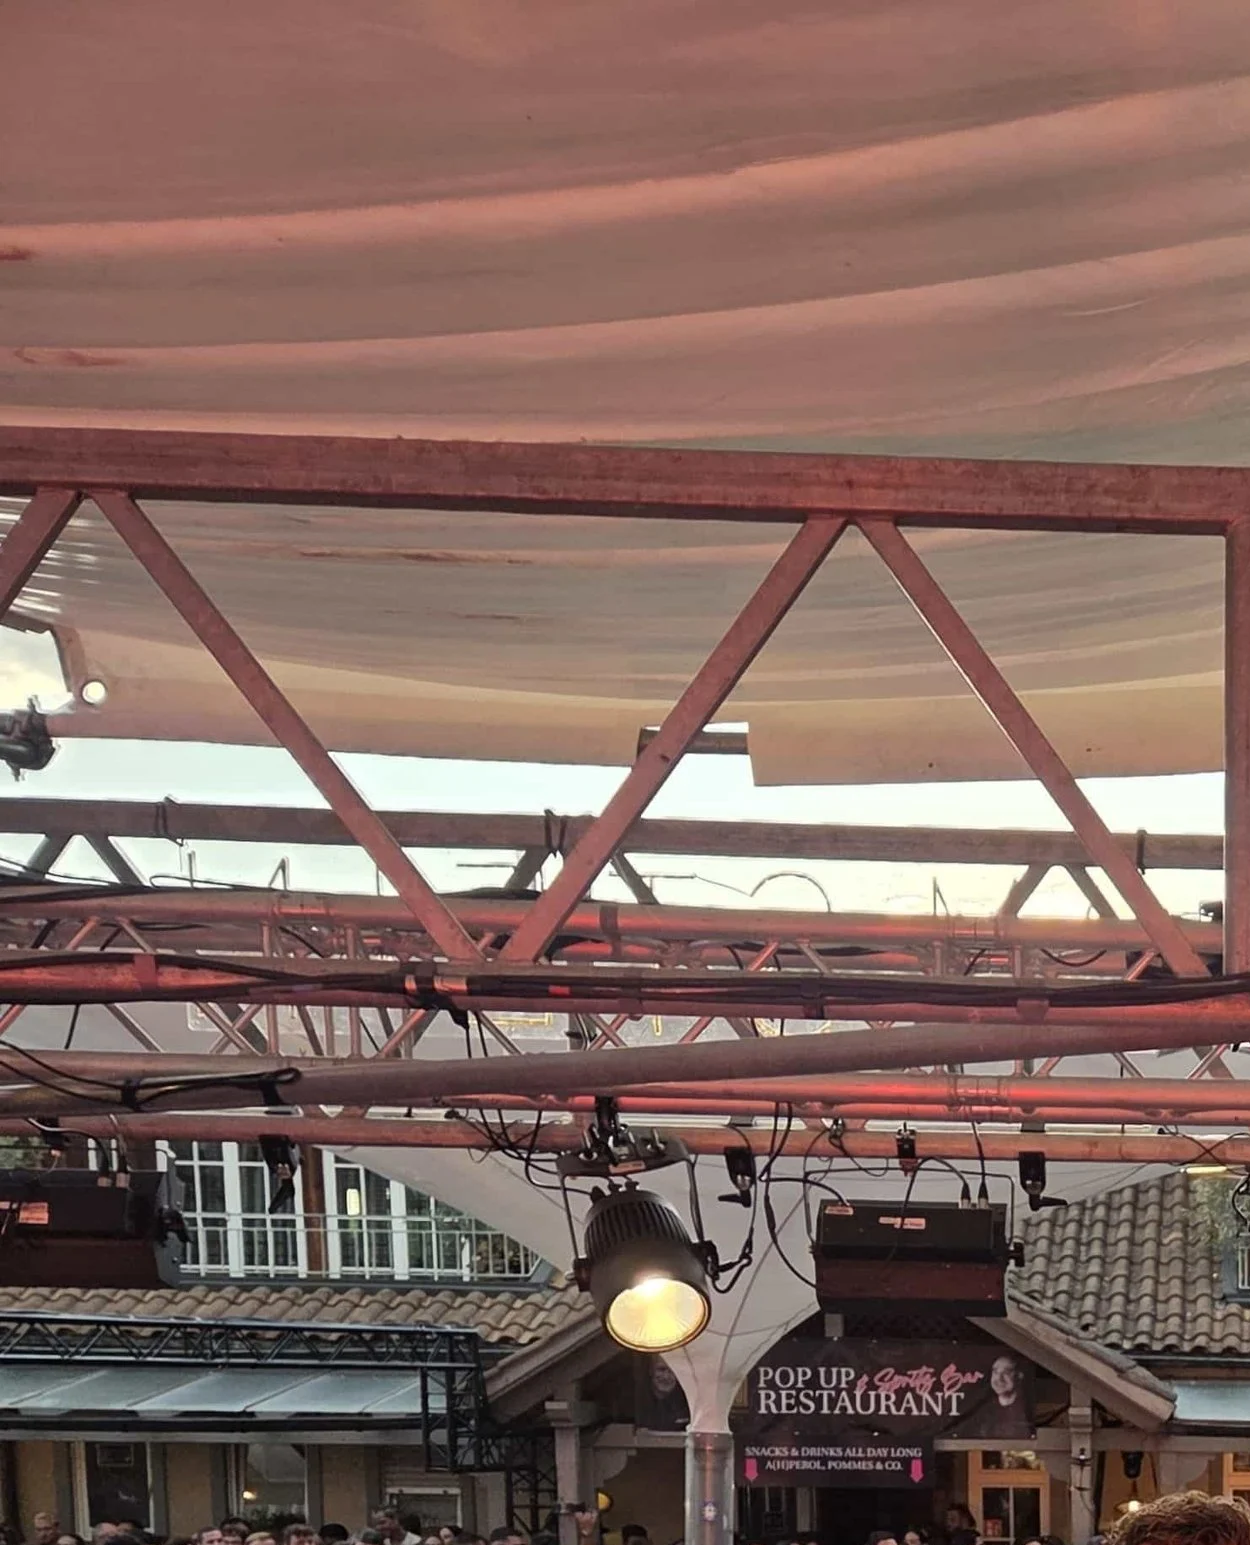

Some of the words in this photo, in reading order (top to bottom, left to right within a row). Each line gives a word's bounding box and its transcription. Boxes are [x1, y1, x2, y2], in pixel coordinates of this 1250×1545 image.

[758, 1366, 812, 1388] POP
[817, 1367, 856, 1389] UP
[758, 1389, 965, 1416] RESTAURANT
[745, 1446, 789, 1457] SNACKS
[790, 1447, 800, 1457] &
[801, 1446, 843, 1457] DRINKS
[844, 1447, 867, 1457] ALL
[867, 1447, 889, 1458] DAY
[890, 1447, 923, 1458] LONG
[827, 1460, 874, 1470] POMMES
[875, 1461, 884, 1470] &
